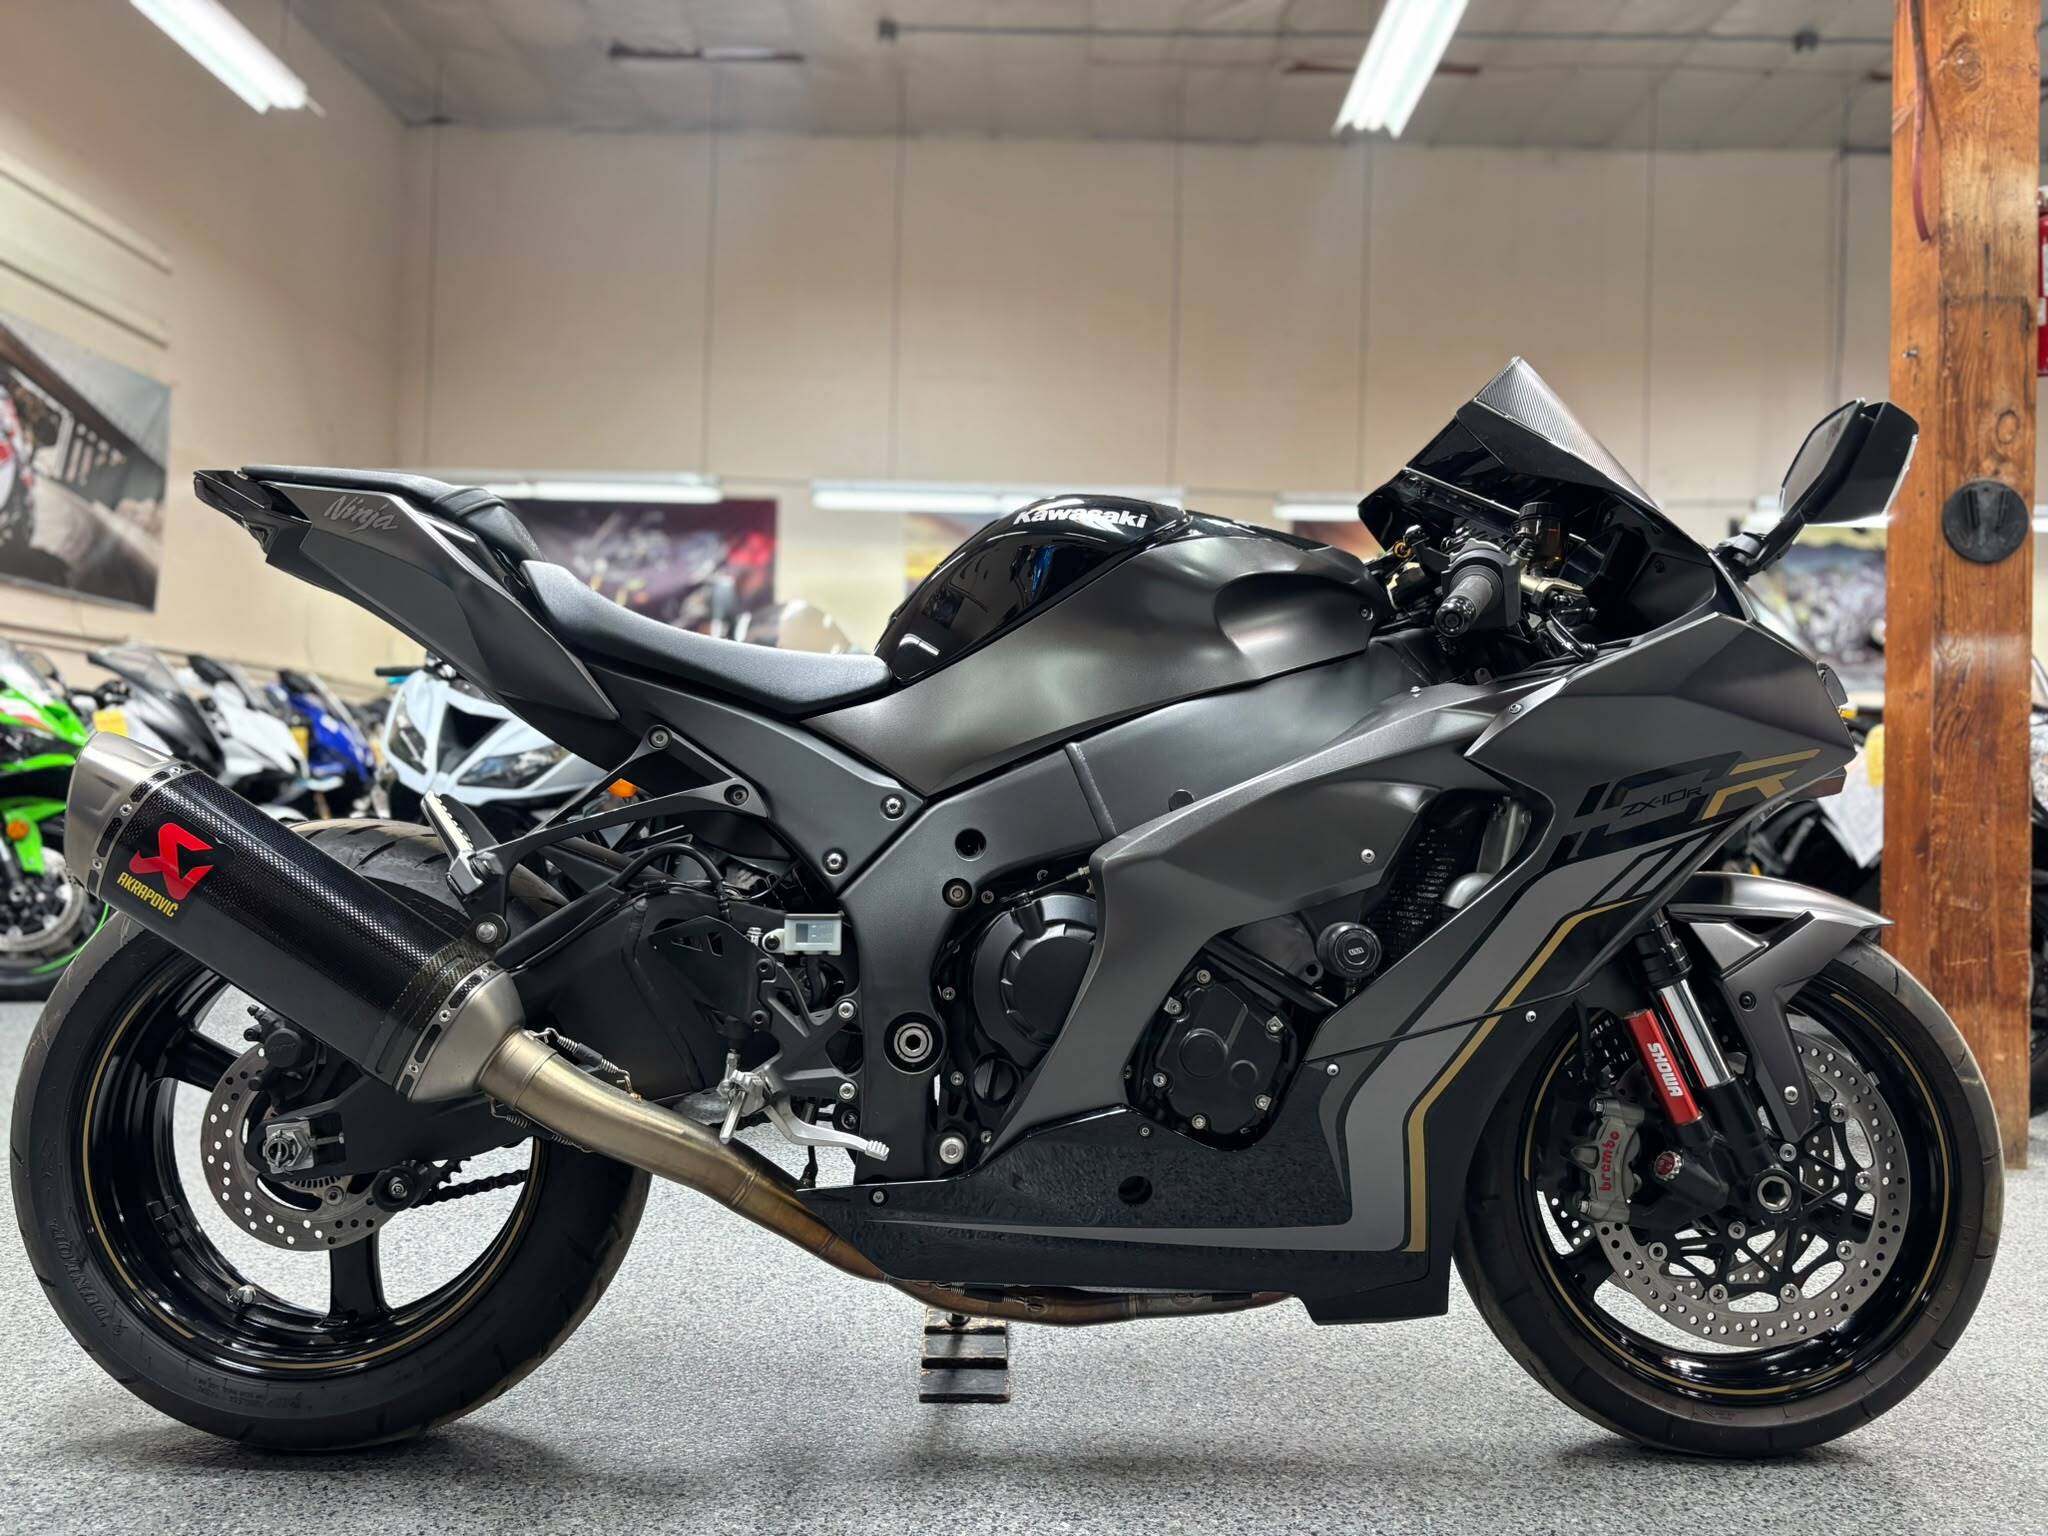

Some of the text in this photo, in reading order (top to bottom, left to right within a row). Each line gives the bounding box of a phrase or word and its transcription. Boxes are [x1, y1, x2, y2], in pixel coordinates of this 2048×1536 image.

[324, 495, 398, 533] Ninja
[1012, 508, 1148, 529] Kawasaki
[1620, 786, 1703, 818] ZX-10R
[1647, 1042, 1684, 1097] SHOWA
[1599, 1131, 1620, 1191] brembo
